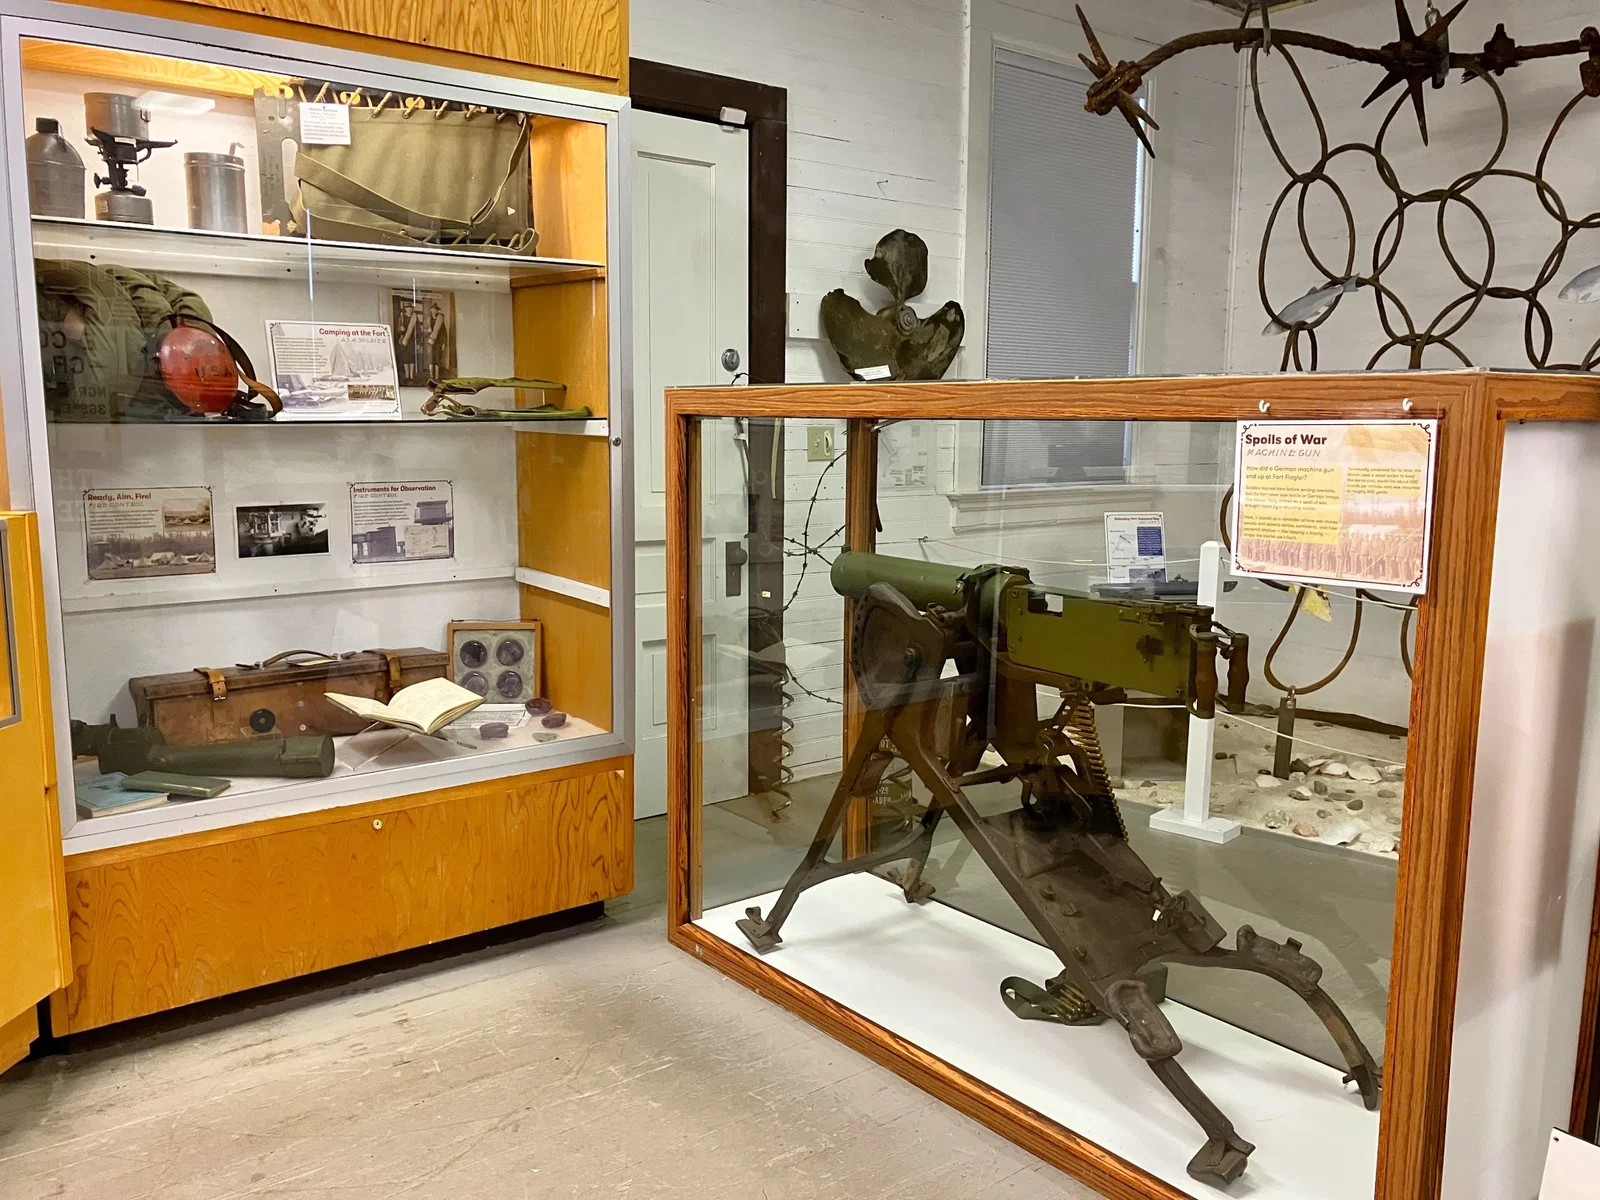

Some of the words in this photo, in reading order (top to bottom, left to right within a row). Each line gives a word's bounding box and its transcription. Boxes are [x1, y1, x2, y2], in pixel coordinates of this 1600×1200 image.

[319, 328, 351, 337] Camping
[1246, 434, 1282, 446] Spoils
[1284, 434, 1298, 445] of
[1301, 434, 1328, 445] War
[1246, 448, 1296, 456] MACHINE
[88, 494, 115, 502] Ready,
